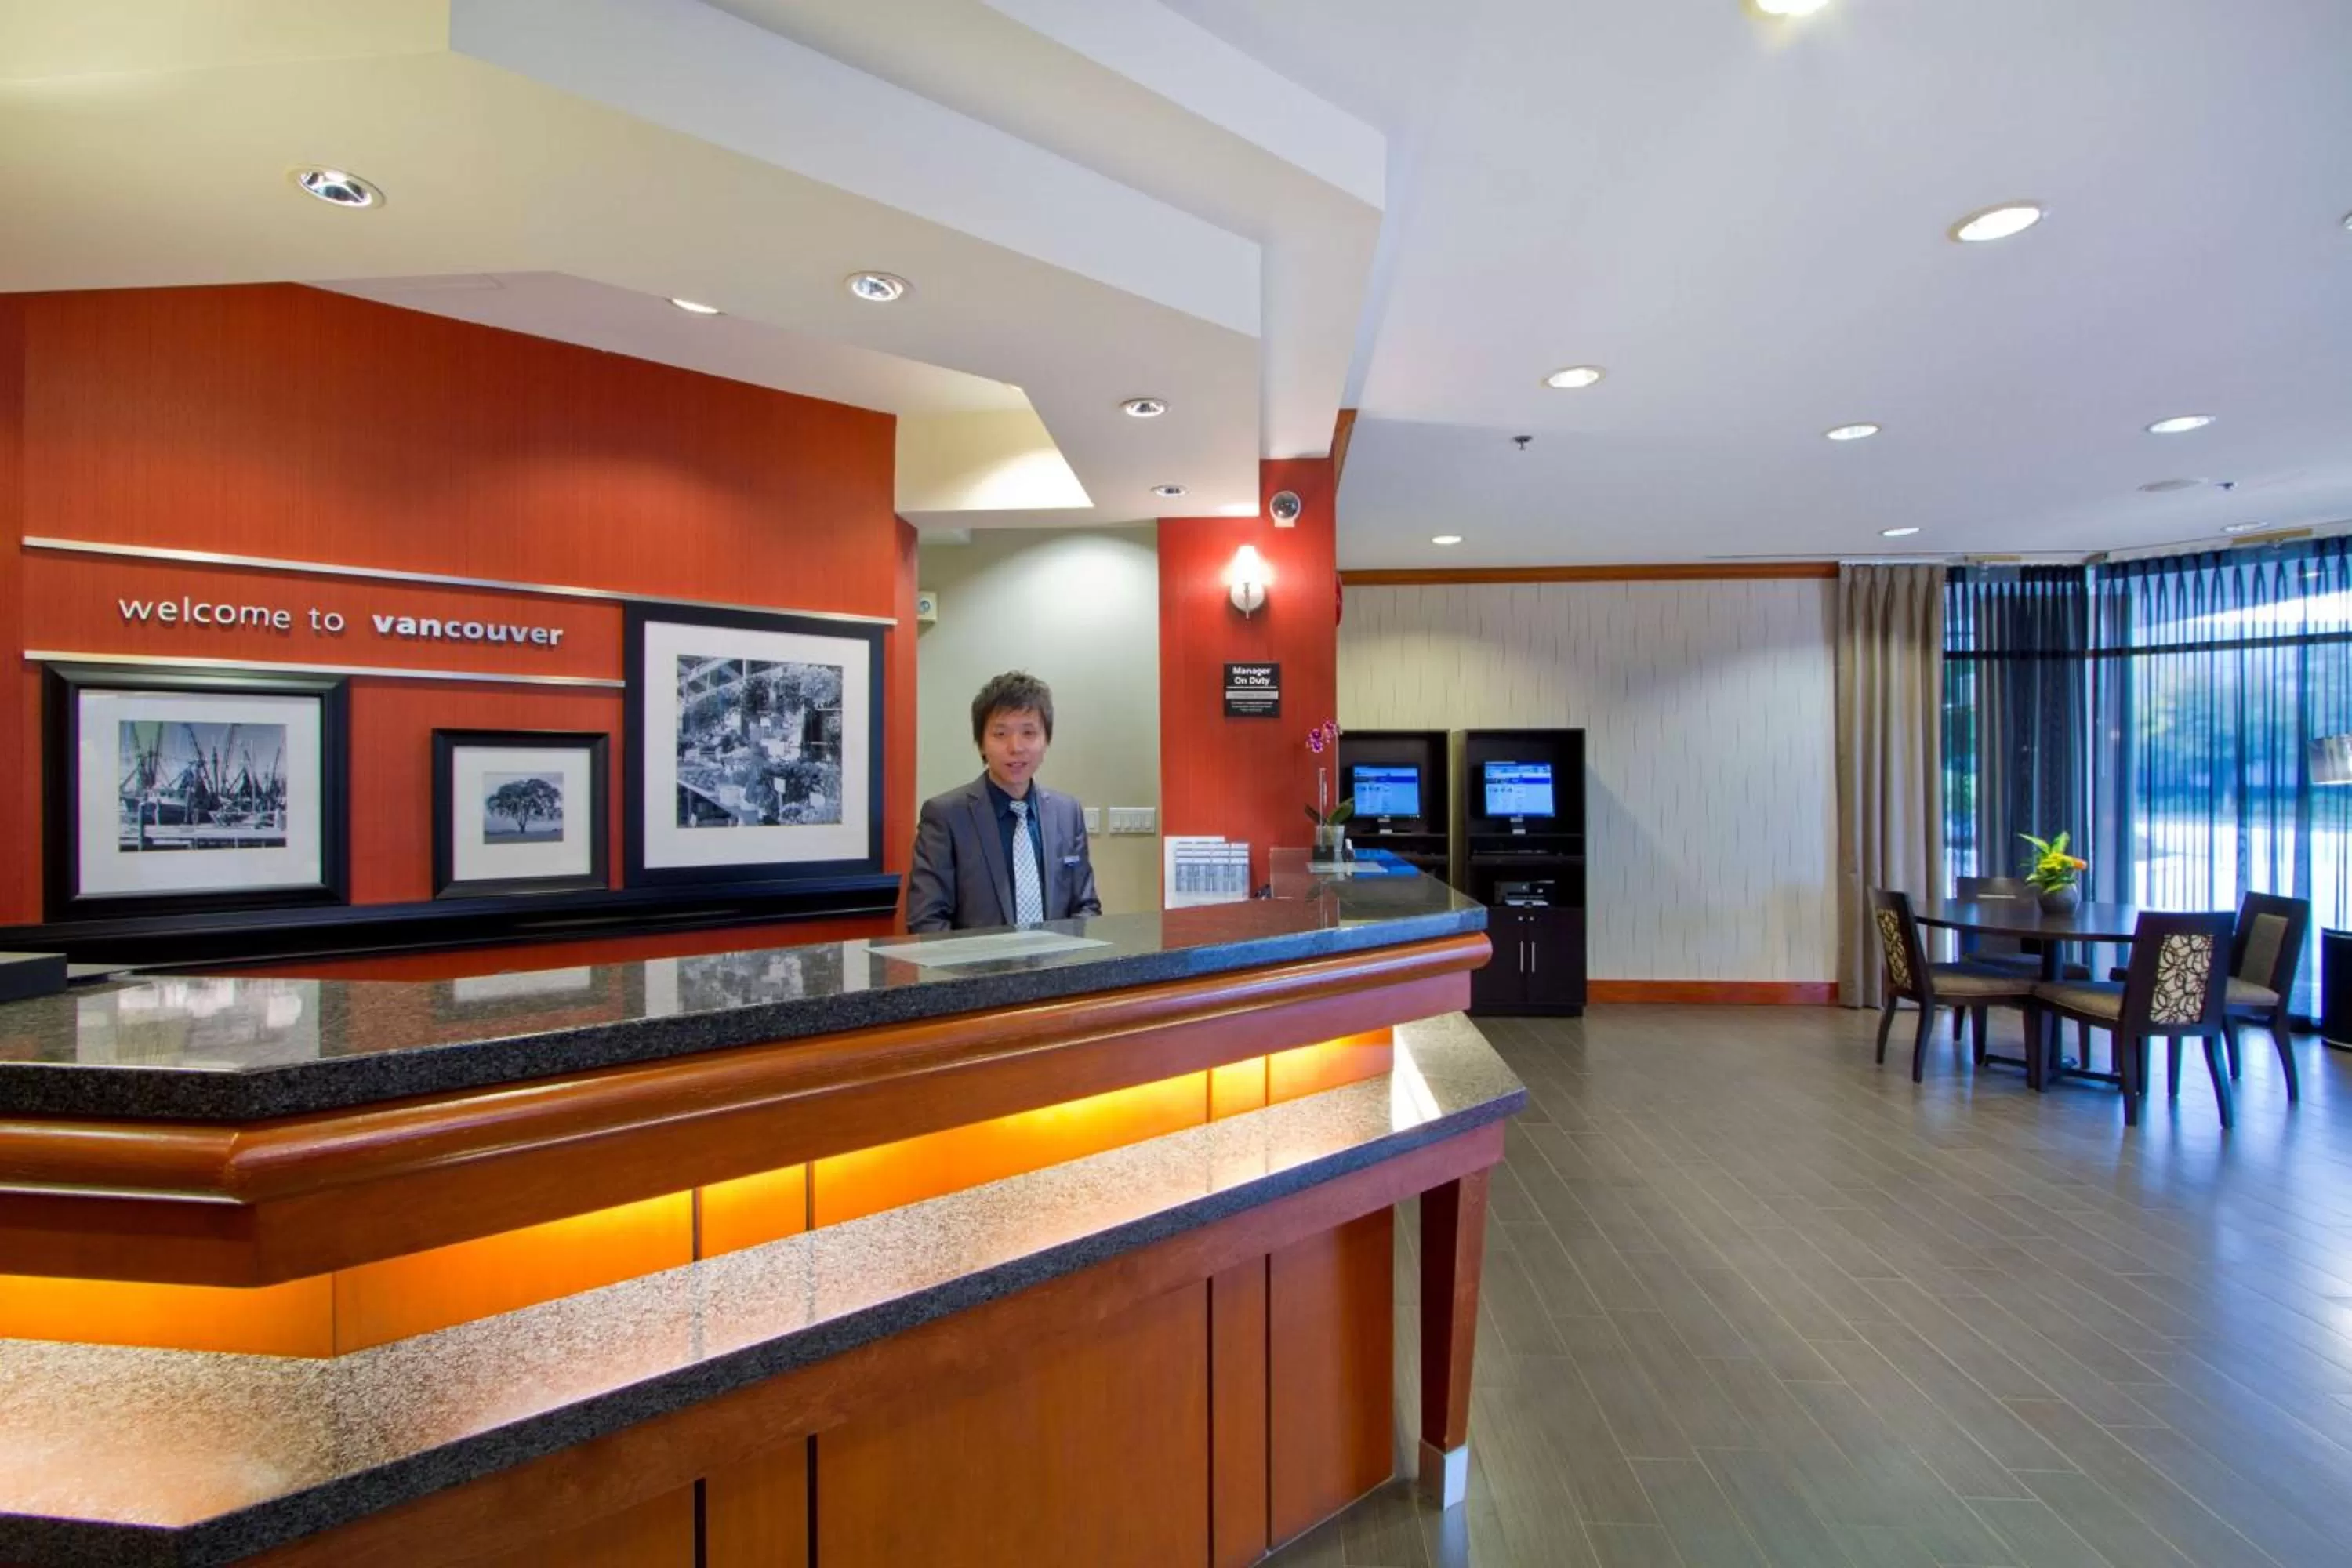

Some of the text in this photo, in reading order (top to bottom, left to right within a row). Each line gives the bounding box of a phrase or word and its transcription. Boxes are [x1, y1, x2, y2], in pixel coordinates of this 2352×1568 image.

[118, 596, 564, 645] welcome to vancouver
[1232, 666, 1271, 677] Manager
[1249, 677, 1270, 687] Duty
